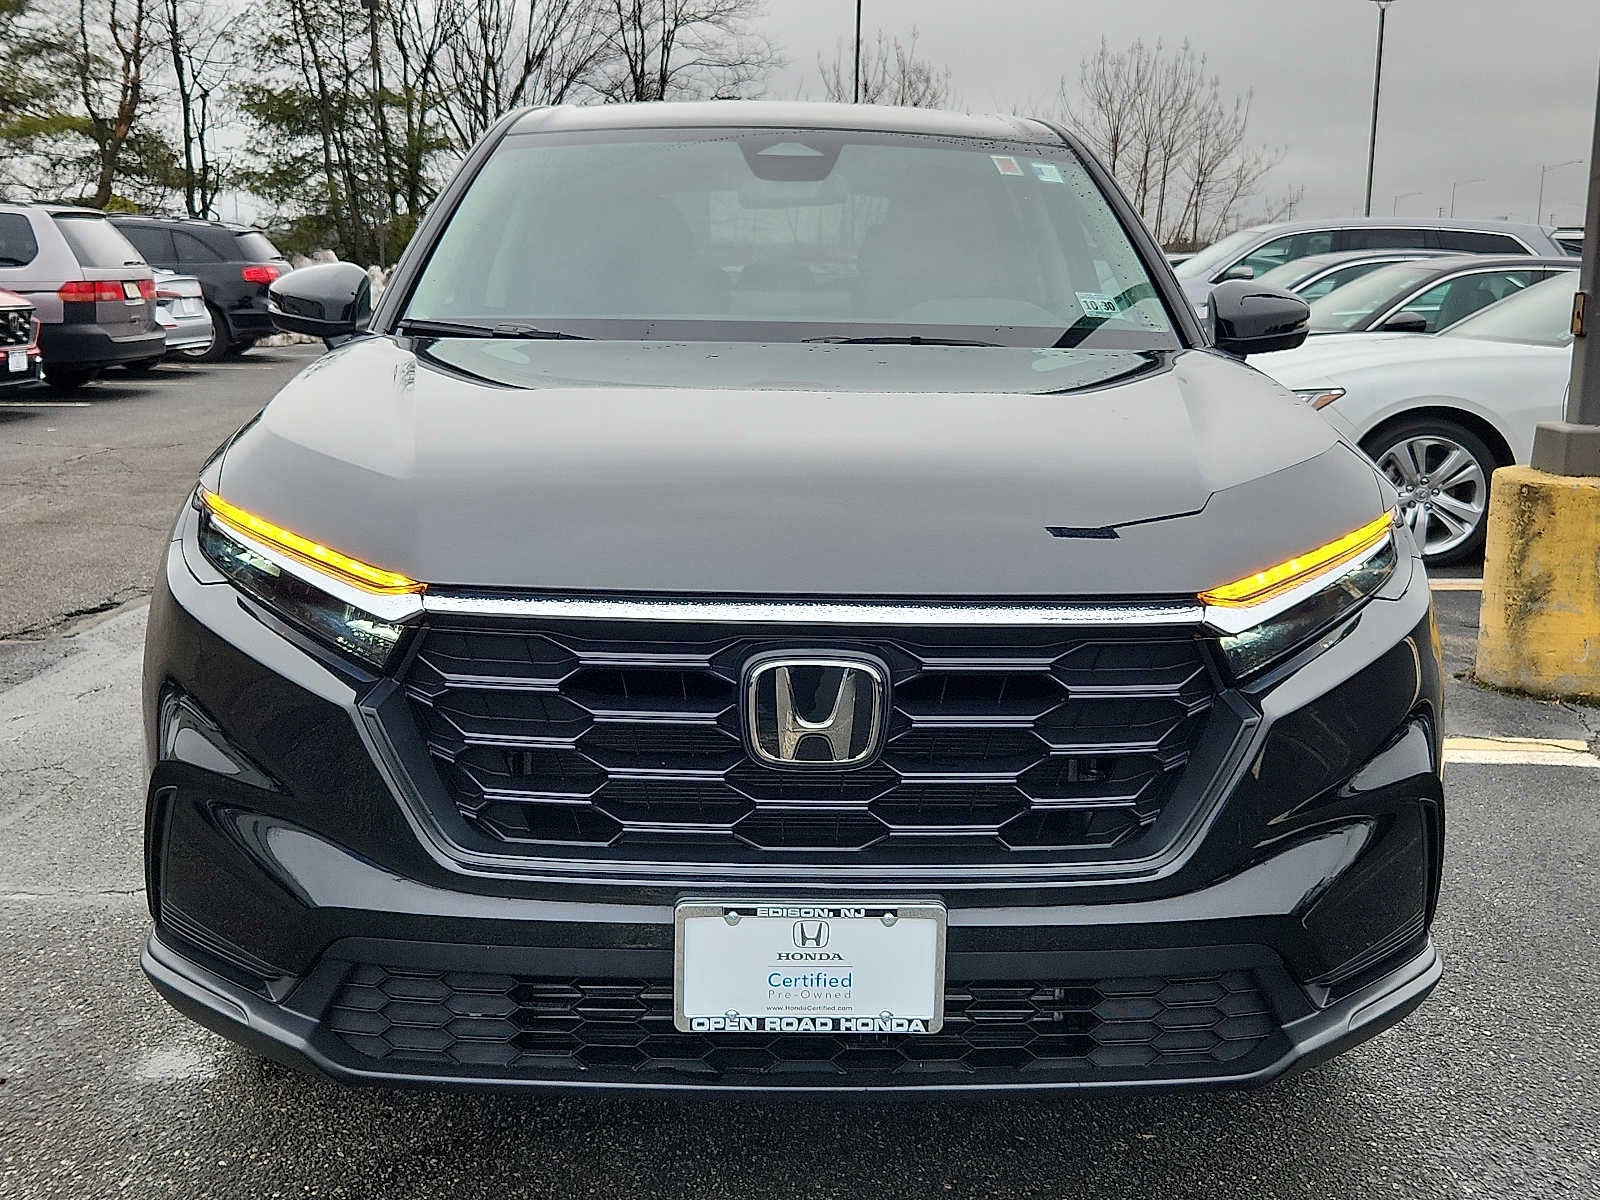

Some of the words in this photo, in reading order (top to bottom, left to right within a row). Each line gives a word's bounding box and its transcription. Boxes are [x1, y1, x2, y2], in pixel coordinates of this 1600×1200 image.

[1082, 300, 1098, 310] 10
[1101, 301, 1116, 311] 30
[757, 907, 834, 918] EDISON,
[840, 908, 866, 918] NJ
[776, 952, 844, 961] HONDA
[767, 972, 853, 988] Certified
[768, 989, 852, 999] Pre-Owned
[691, 1017, 757, 1032] OPEN
[764, 1017, 833, 1032] ROAD
[839, 1018, 926, 1033] HONDA
